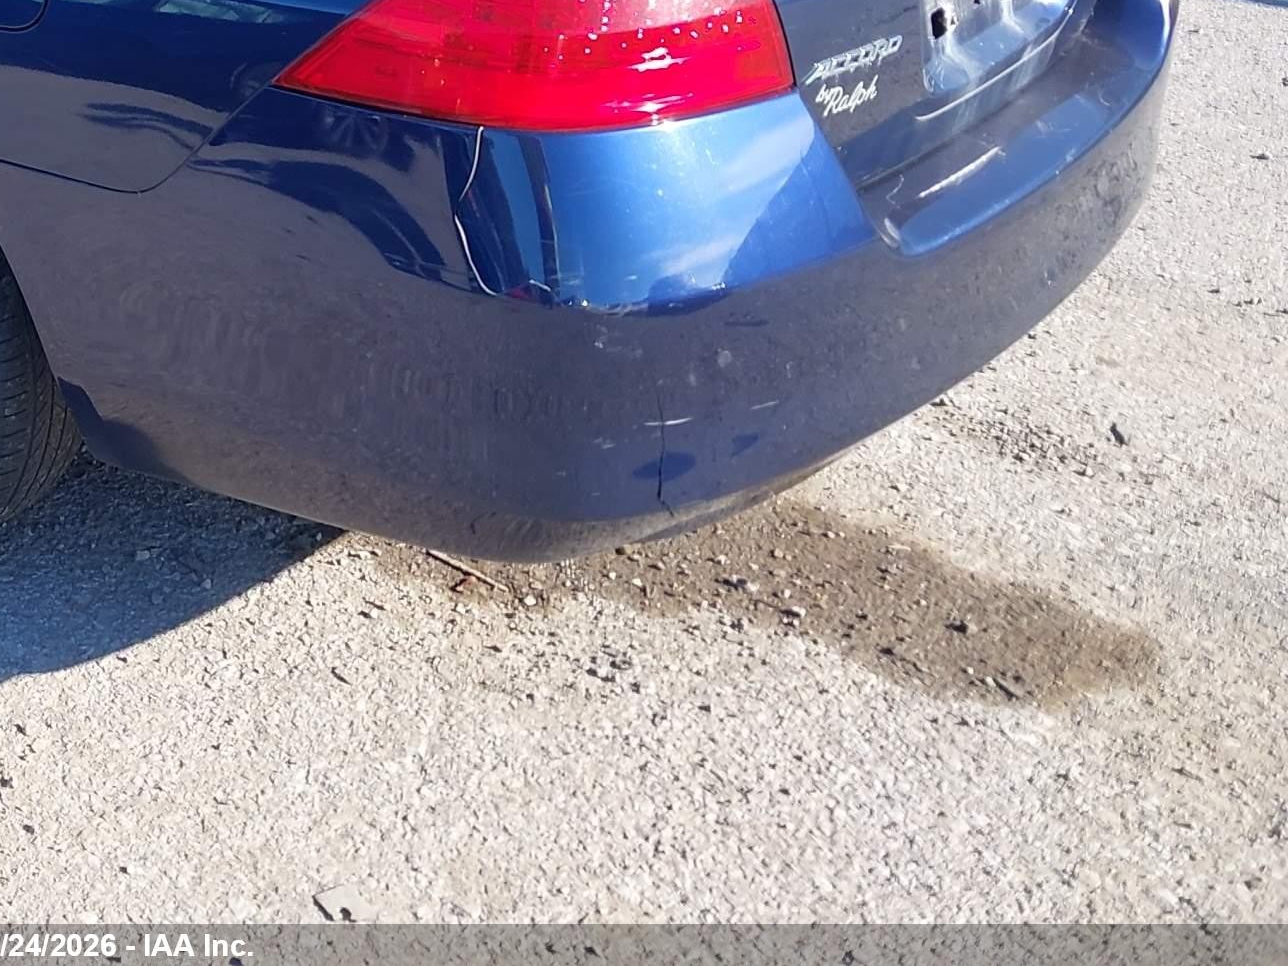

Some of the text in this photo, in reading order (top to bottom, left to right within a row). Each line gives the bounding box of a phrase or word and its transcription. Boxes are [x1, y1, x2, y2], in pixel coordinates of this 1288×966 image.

[802, 35, 903, 85] ACCORD
[815, 74, 878, 117] by Ralph
